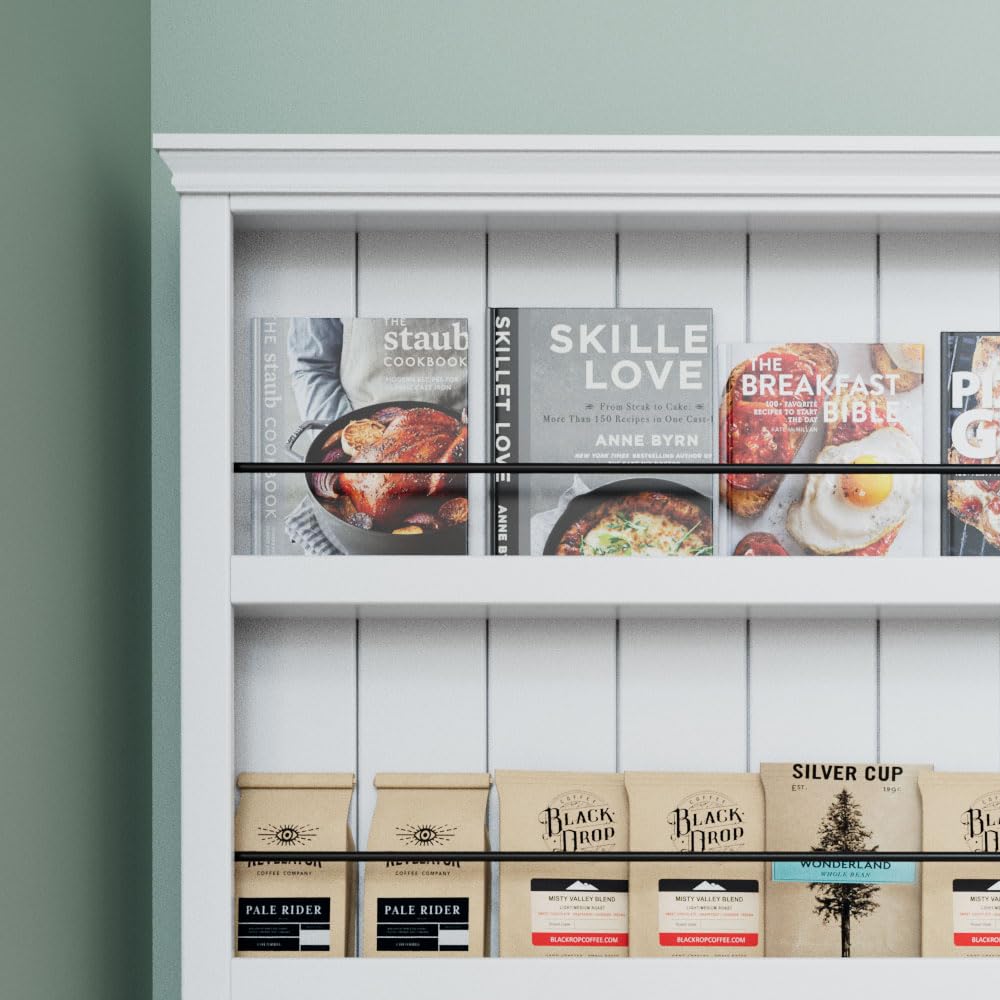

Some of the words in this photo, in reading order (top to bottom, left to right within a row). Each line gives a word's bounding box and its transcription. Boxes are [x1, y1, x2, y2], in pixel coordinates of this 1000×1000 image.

[384, 318, 406, 326] THE
[384, 322, 468, 350] staub
[549, 323, 708, 354] SKILLE
[384, 357, 467, 367] COOKBOOK
[495, 316, 511, 411] SKILLET
[750, 358, 782, 372] THE
[264, 353, 281, 408] staub
[585, 360, 703, 390] LOVE
[742, 373, 900, 397] BREAKFAST
[600, 403, 623, 411] From
[626, 403, 650, 411] Steak
[654, 403, 663, 411] to
[823, 401, 900, 423] BIBLE
[543, 415, 566, 423] More
[569, 415, 591, 423] Than
[595, 415, 612, 423] 150
[616, 415, 650, 425] Recipes
[653, 415, 662, 423] in
[665, 415, 683, 423] One
[495, 423, 511, 482] LOVE
[595, 434, 645, 447] ANNE
[651, 434, 698, 447] BYRN
[498, 505, 508, 541] ANNE
[792, 763, 857, 781] SILVER
[865, 766, 903, 782] CUP
[538, 806, 614, 837] BLACK
[667, 806, 743, 837] BLACK
[562, 827, 615, 852] DROP
[691, 827, 744, 852] DROP
[800, 861, 891, 869] WONDERLAND
[246, 905, 277, 915] PALE
[281, 905, 322, 915] RIDER
[384, 905, 416, 915] PALE
[420, 905, 461, 915] RIDER
